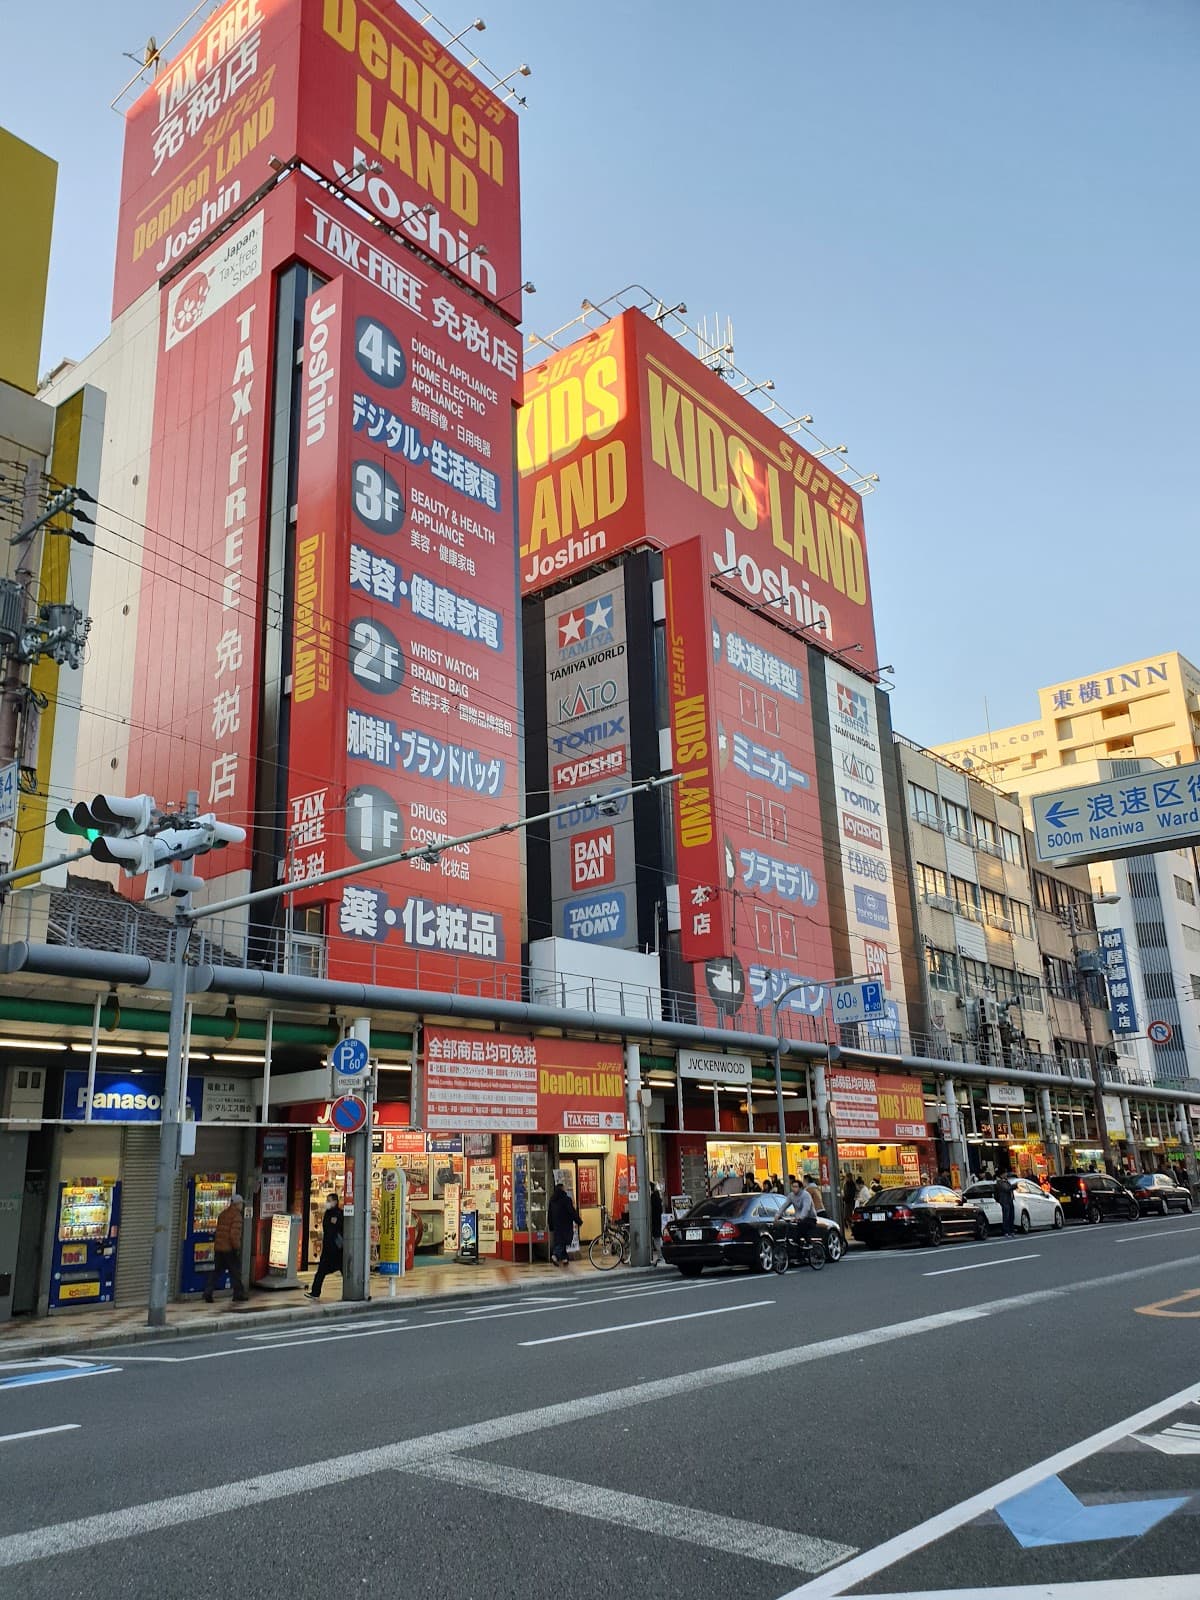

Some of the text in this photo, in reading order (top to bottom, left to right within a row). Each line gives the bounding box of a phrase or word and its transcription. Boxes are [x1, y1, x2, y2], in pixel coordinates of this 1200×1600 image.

[151, 28, 261, 176] 免税店
[203, 64, 276, 145] SUPER
[323, 0, 504, 187] DenDen
[421, 39, 506, 125] SUPER
[356, 74, 478, 227] LAND
[133, 97, 275, 262] DenDen LAND
[156, 179, 241, 272] Joshin
[333, 147, 497, 296] Joshin
[311, 209, 423, 314] TAX-FREE
[358, 323, 402, 380] 4F
[432, 296, 519, 382] 免税店
[536, 328, 616, 390] SUPER
[307, 298, 336, 447] Joshin
[412, 338, 498, 405] DIGITAL APPLIANCE
[412, 358, 486, 416] HOME ELECTRIC
[412, 377, 463, 419] APPLIANCE
[355, 464, 400, 524] 3F
[520, 440, 627, 558] AND
[648, 368, 867, 606] KIDS LAND
[777, 441, 858, 525] SUPER
[411, 488, 495, 545] BEAUTY & HEALTH
[411, 507, 465, 548] APPLIANCE
[525, 530, 606, 583] Joshin
[713, 528, 832, 641] Joshin
[295, 634, 316, 702] LAND
[353, 622, 399, 684] 2F
[410, 640, 479, 681] WRIST WATCH
[550, 645, 625, 682] TAMIYA WORLD
[559, 631, 615, 660] TAMIYA
[672, 636, 686, 697] SUPER
[726, 632, 799, 699] 鉄道模型
[411, 663, 469, 698] BRAND BAG
[559, 680, 617, 721] KATO
[208, 628, 243, 805] 免税店
[553, 715, 625, 753] TOMIX
[834, 724, 876, 752] TAMIYA WORLD
[674, 694, 712, 848] KIDS LAND
[733, 734, 805, 787] ミニカー
[841, 752, 874, 784] KATO
[292, 792, 325, 822] TAX
[354, 794, 398, 852] 1F
[410, 803, 447, 826] DRUGS
[840, 786, 881, 816] TOMIX
[291, 816, 325, 844] FREE
[574, 835, 612, 864] BAN
[1047, 808, 1199, 848] 500m Naniwa Ward
[575, 857, 605, 884] DAI
[740, 851, 814, 901] プラモデル
[340, 886, 497, 957] 薬・化粧品
[569, 900, 620, 922] TAKARA
[570, 917, 619, 941] TOMY
[691, 885, 711, 936] 本店
[866, 944, 888, 965] BAN
[866, 986, 877, 999] P
[340, 1047, 355, 1070] P
[429, 1036, 537, 1065] 全部商品均可免税
[597, 1062, 622, 1073] SUPER
[540, 1070, 590, 1096] DenDen
[592, 1073, 623, 1097] LAND
[878, 1094, 924, 1120] KIDS LAND
[568, 1113, 599, 1126] TAX-FREE
[904, 1155, 916, 1164] TAX
